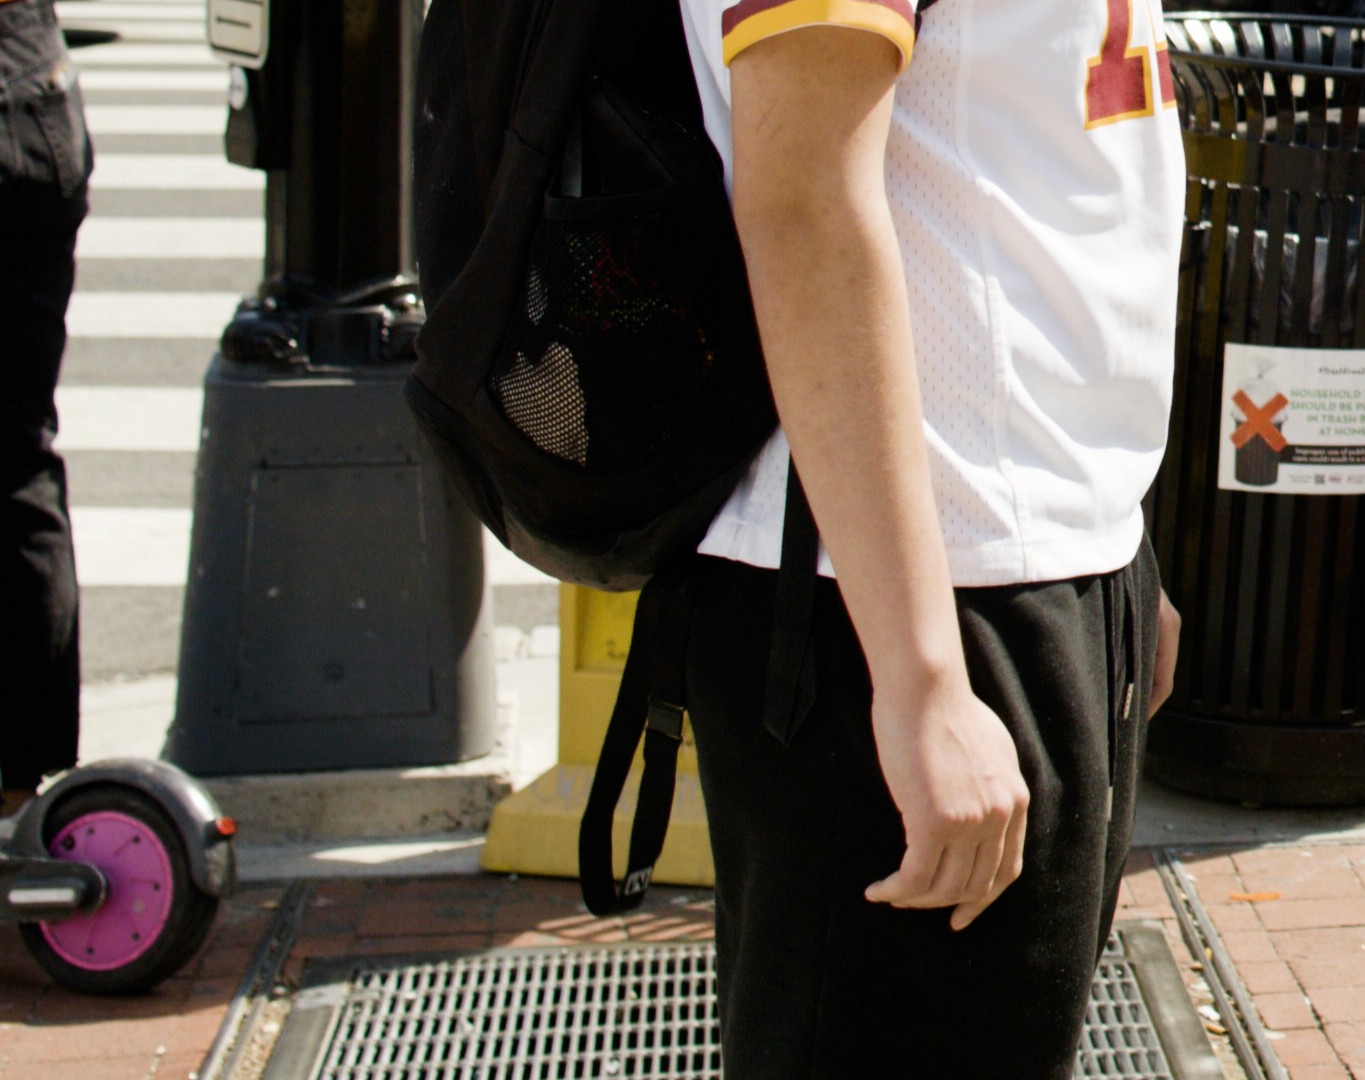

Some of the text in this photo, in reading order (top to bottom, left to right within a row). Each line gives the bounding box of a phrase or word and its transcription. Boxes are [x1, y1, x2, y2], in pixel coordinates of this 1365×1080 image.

[1290, 388, 1360, 398] HOUSEHOLD
[1291, 401, 1336, 411] SHOULD
[1340, 401, 1353, 411] BE
[1306, 414, 1318, 423] IN
[1321, 414, 1357, 423] TRASH
[1319, 427, 1332, 436] AT
